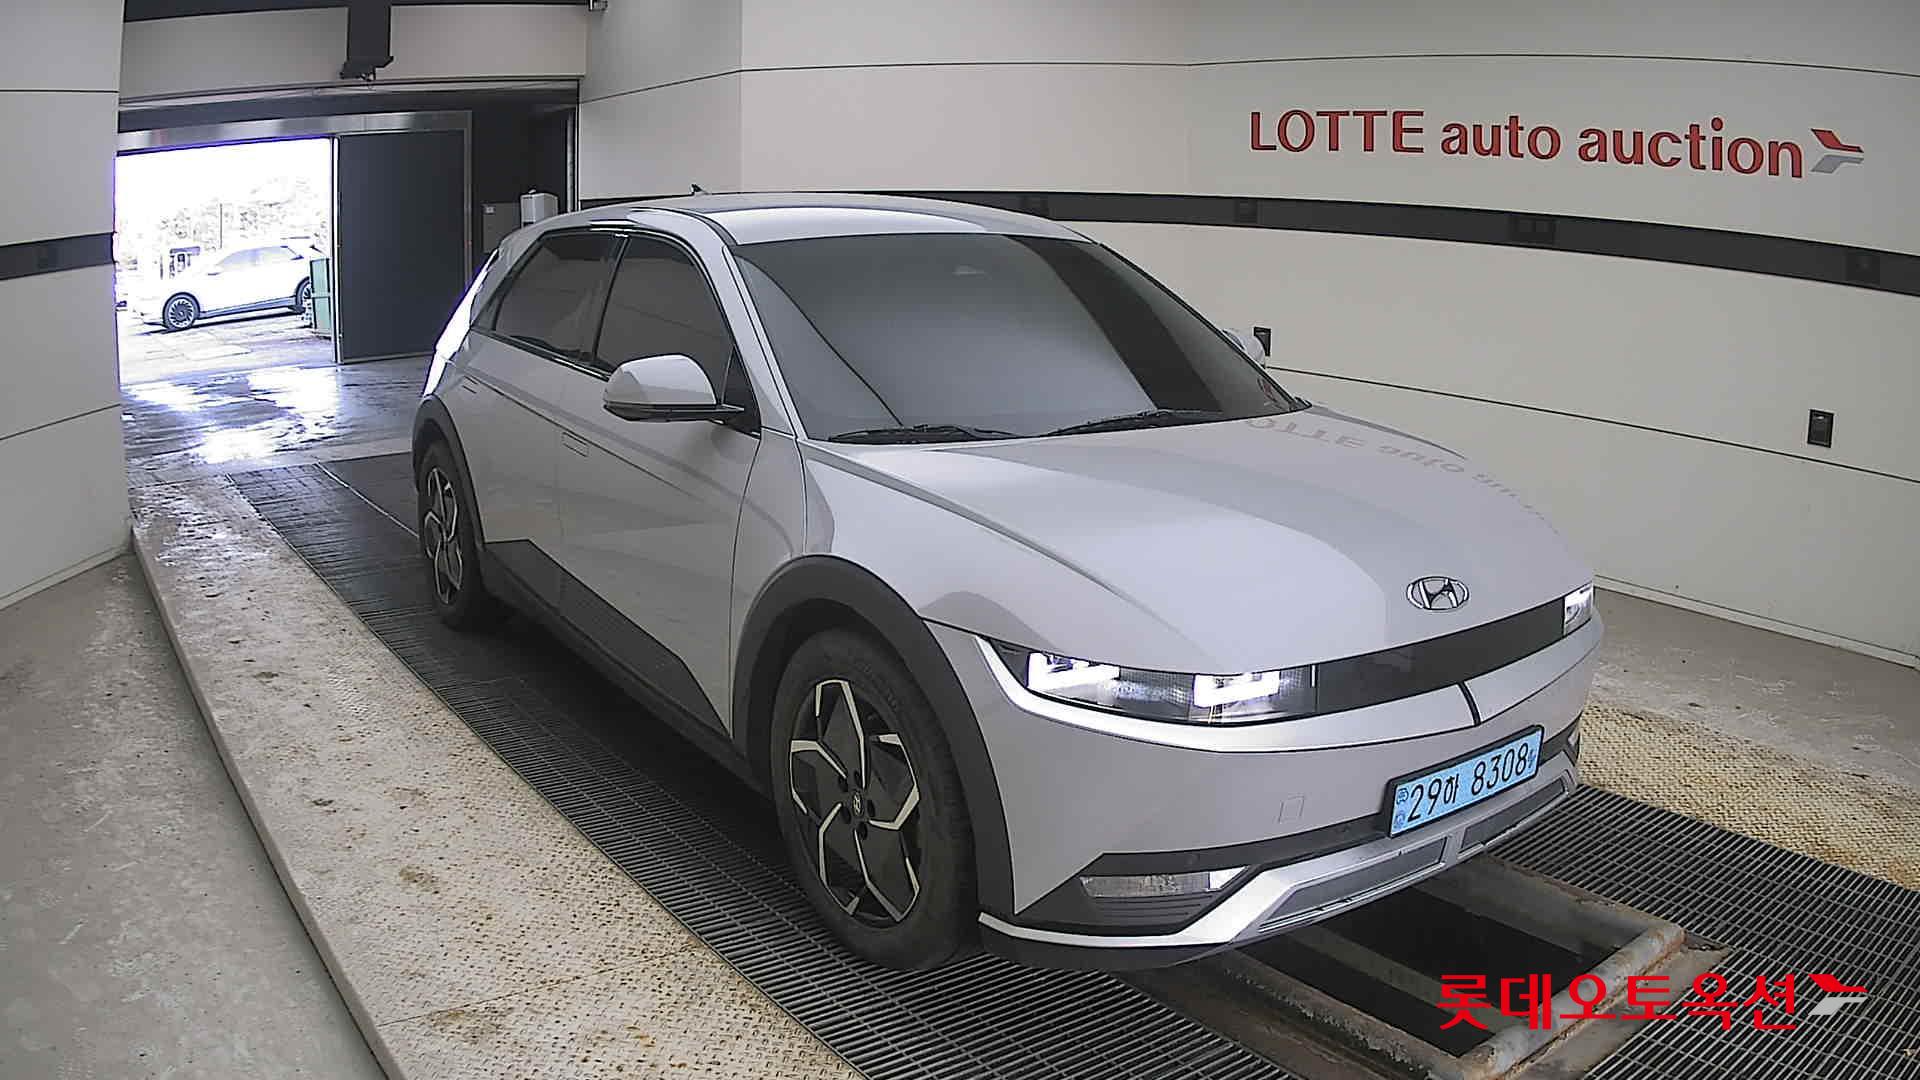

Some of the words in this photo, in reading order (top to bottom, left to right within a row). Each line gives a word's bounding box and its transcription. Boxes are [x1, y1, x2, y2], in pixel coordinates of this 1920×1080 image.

[1250, 110, 1425, 156] LOTTE
[1441, 115, 1563, 160] auto
[1577, 117, 1805, 178] auction
[1406, 772, 1461, 823] 29하
[1470, 742, 1529, 796] 8308
